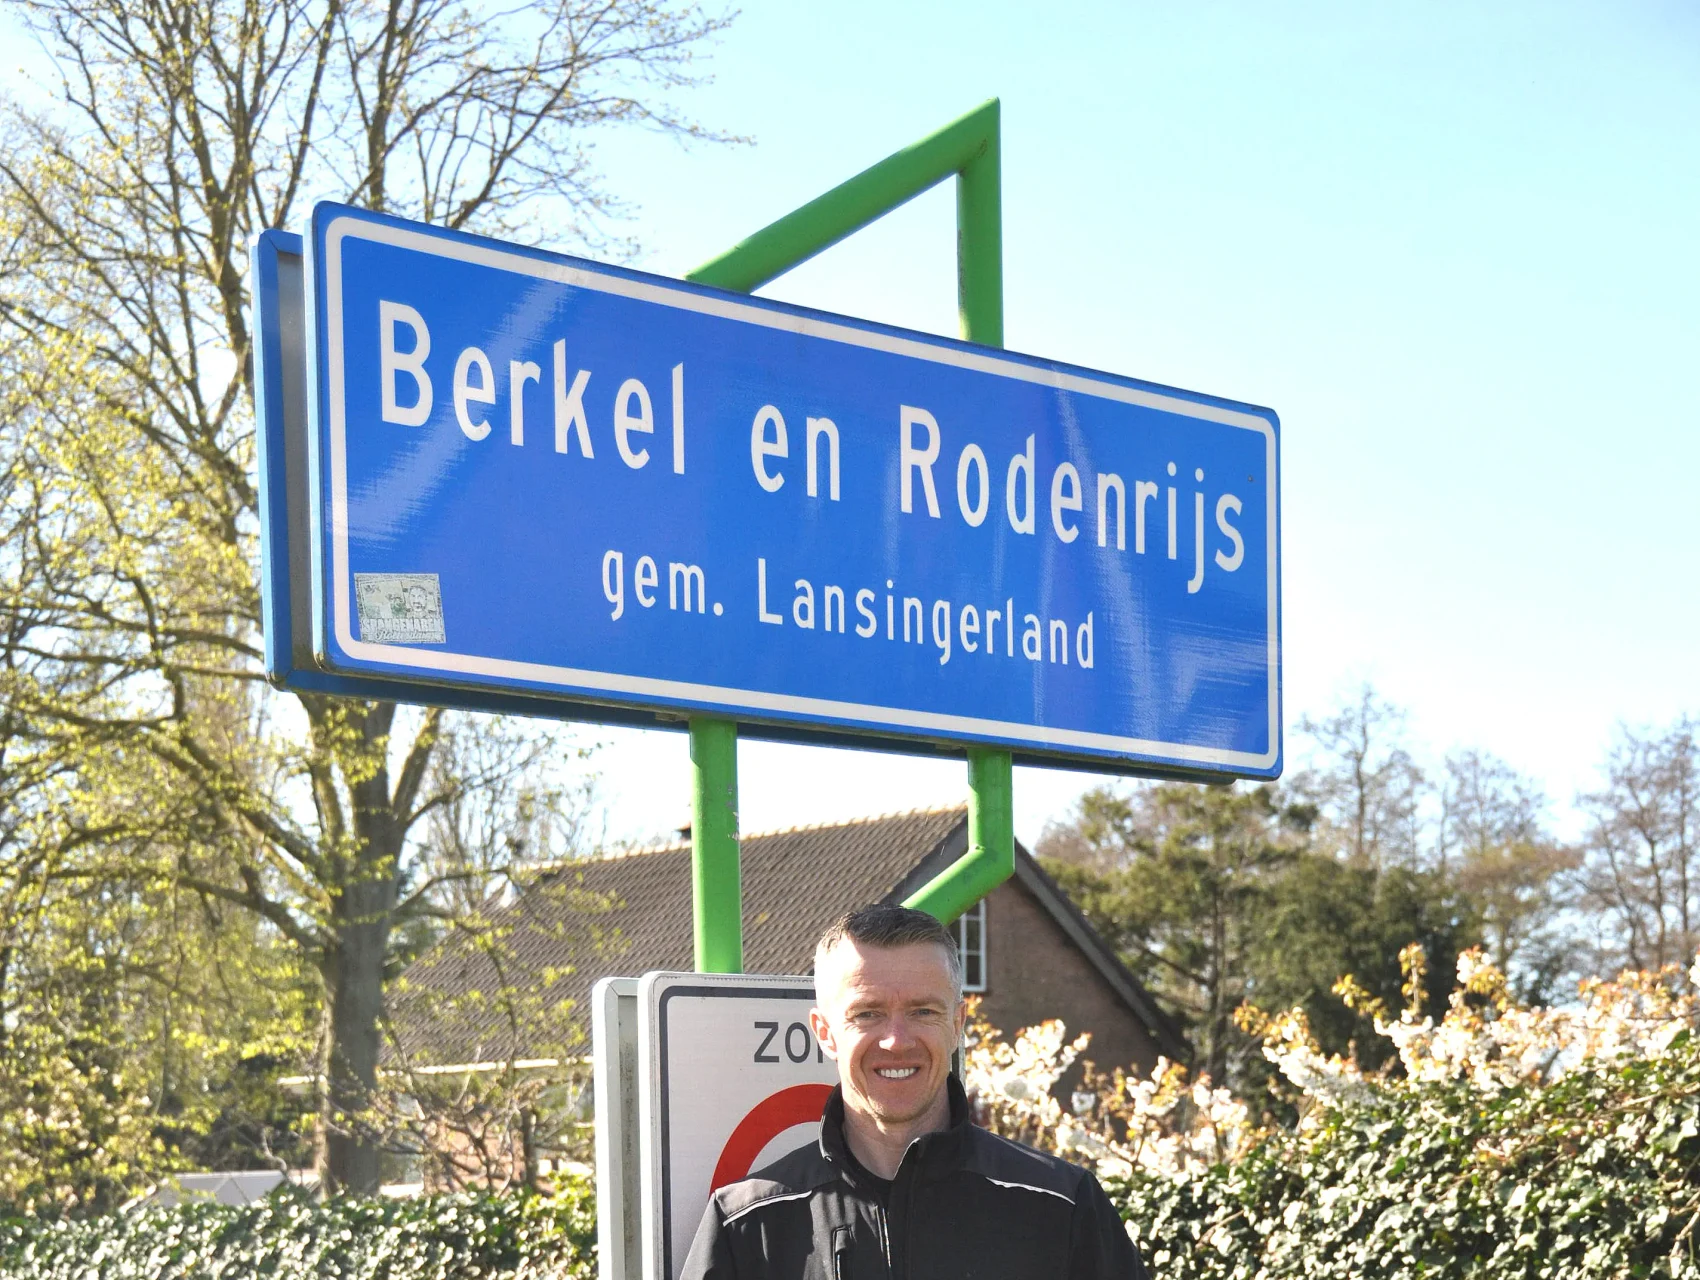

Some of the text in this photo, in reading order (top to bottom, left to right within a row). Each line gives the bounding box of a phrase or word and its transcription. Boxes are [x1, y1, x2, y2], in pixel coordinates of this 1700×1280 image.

[379, 299, 1246, 594] Berkel en Rodenrijs
[602, 549, 1095, 669] gem. Lansingerland
[753, 1021, 824, 1064] ZO
